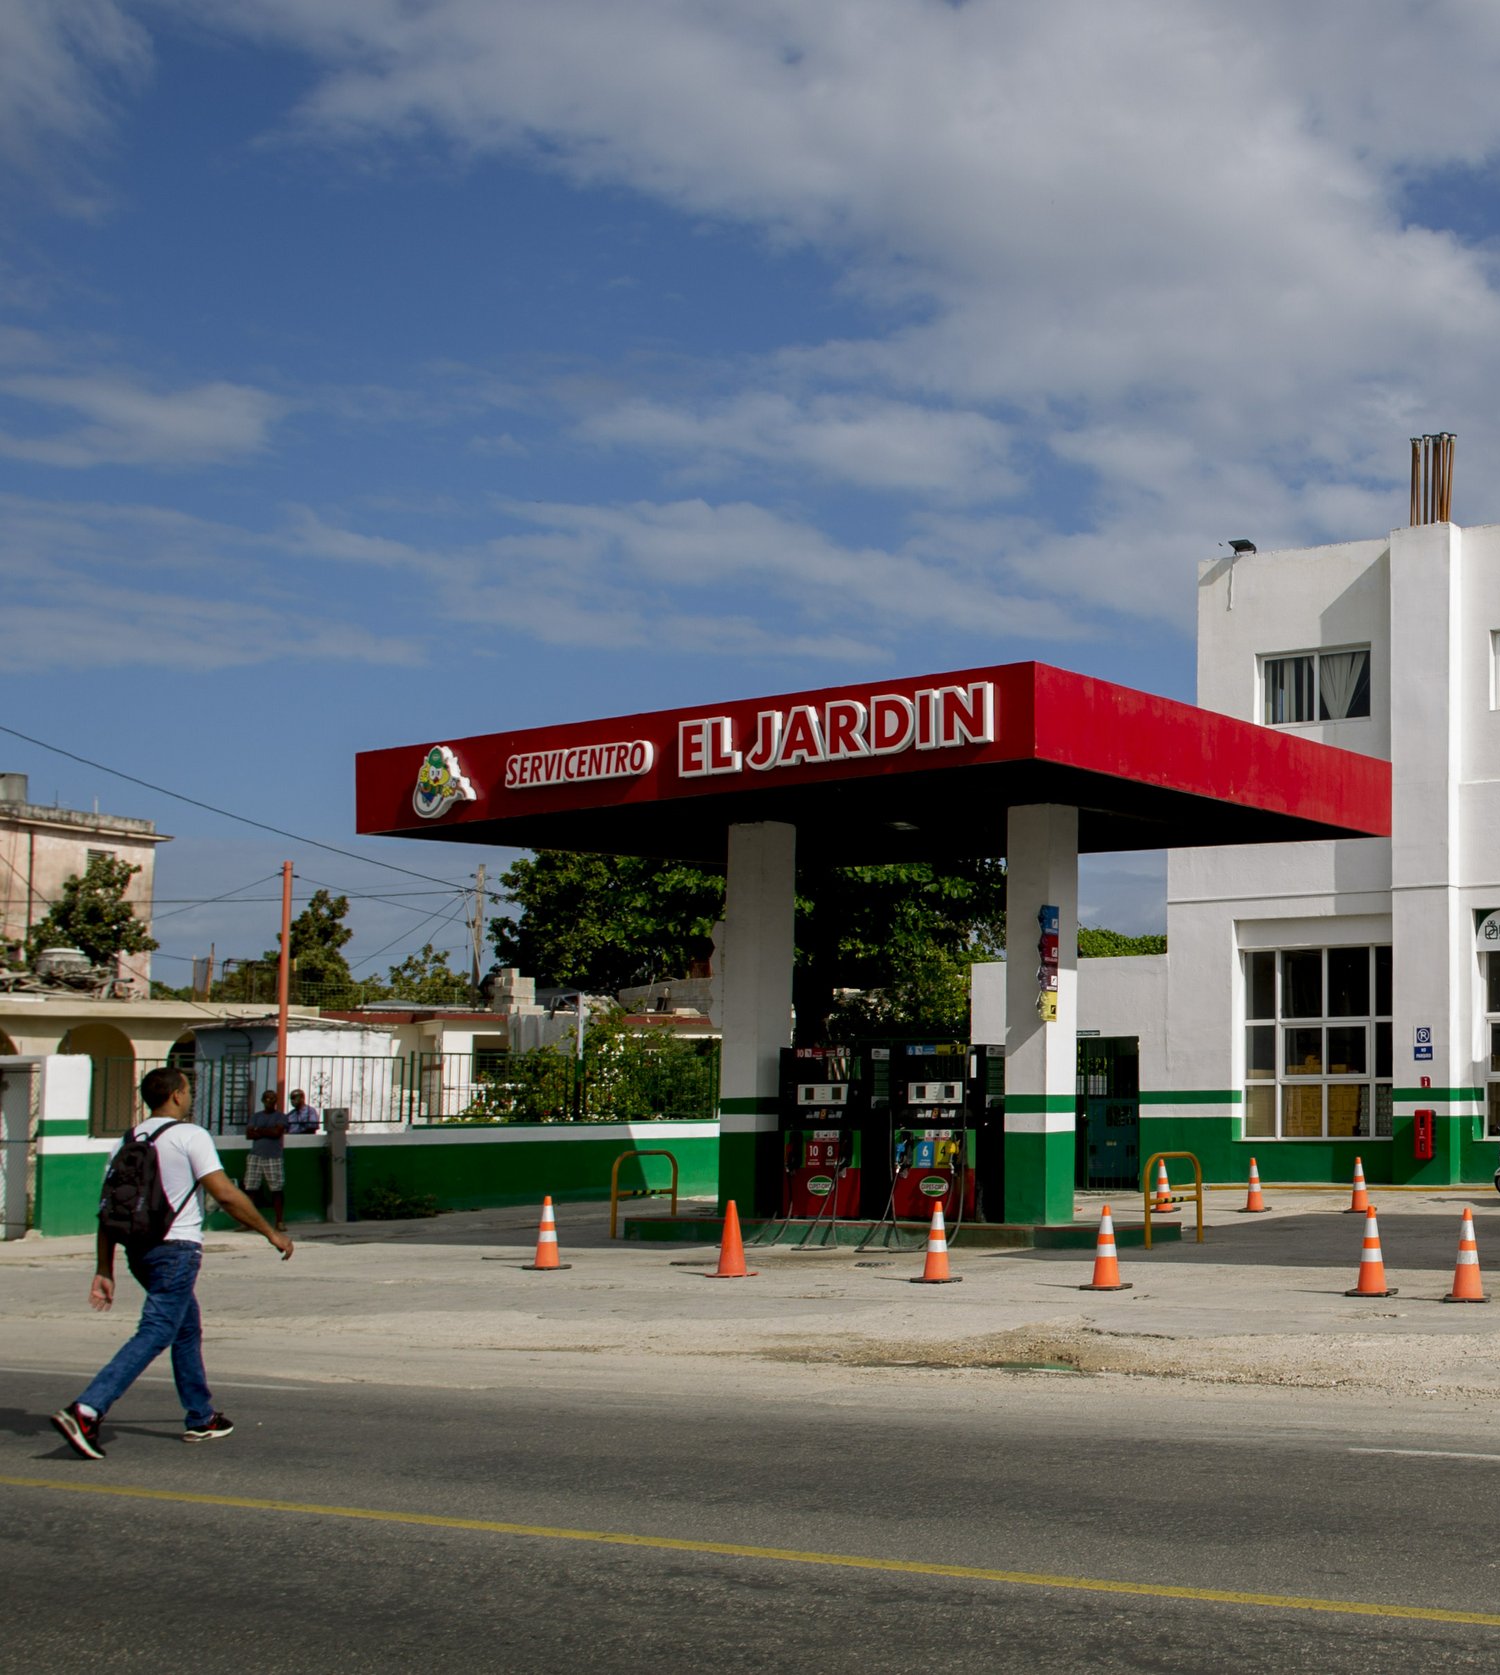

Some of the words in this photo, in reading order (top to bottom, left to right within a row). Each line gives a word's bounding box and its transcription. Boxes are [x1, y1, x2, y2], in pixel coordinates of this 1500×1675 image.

[679, 717, 739, 777] EL
[746, 683, 990, 770] JARDIN
[505, 741, 650, 788] SERVICENTRO
[809, 1145, 819, 1157] 10
[827, 1145, 834, 1157] 8
[922, 1145, 929, 1157] 6
[940, 1145, 946, 1157] 4
